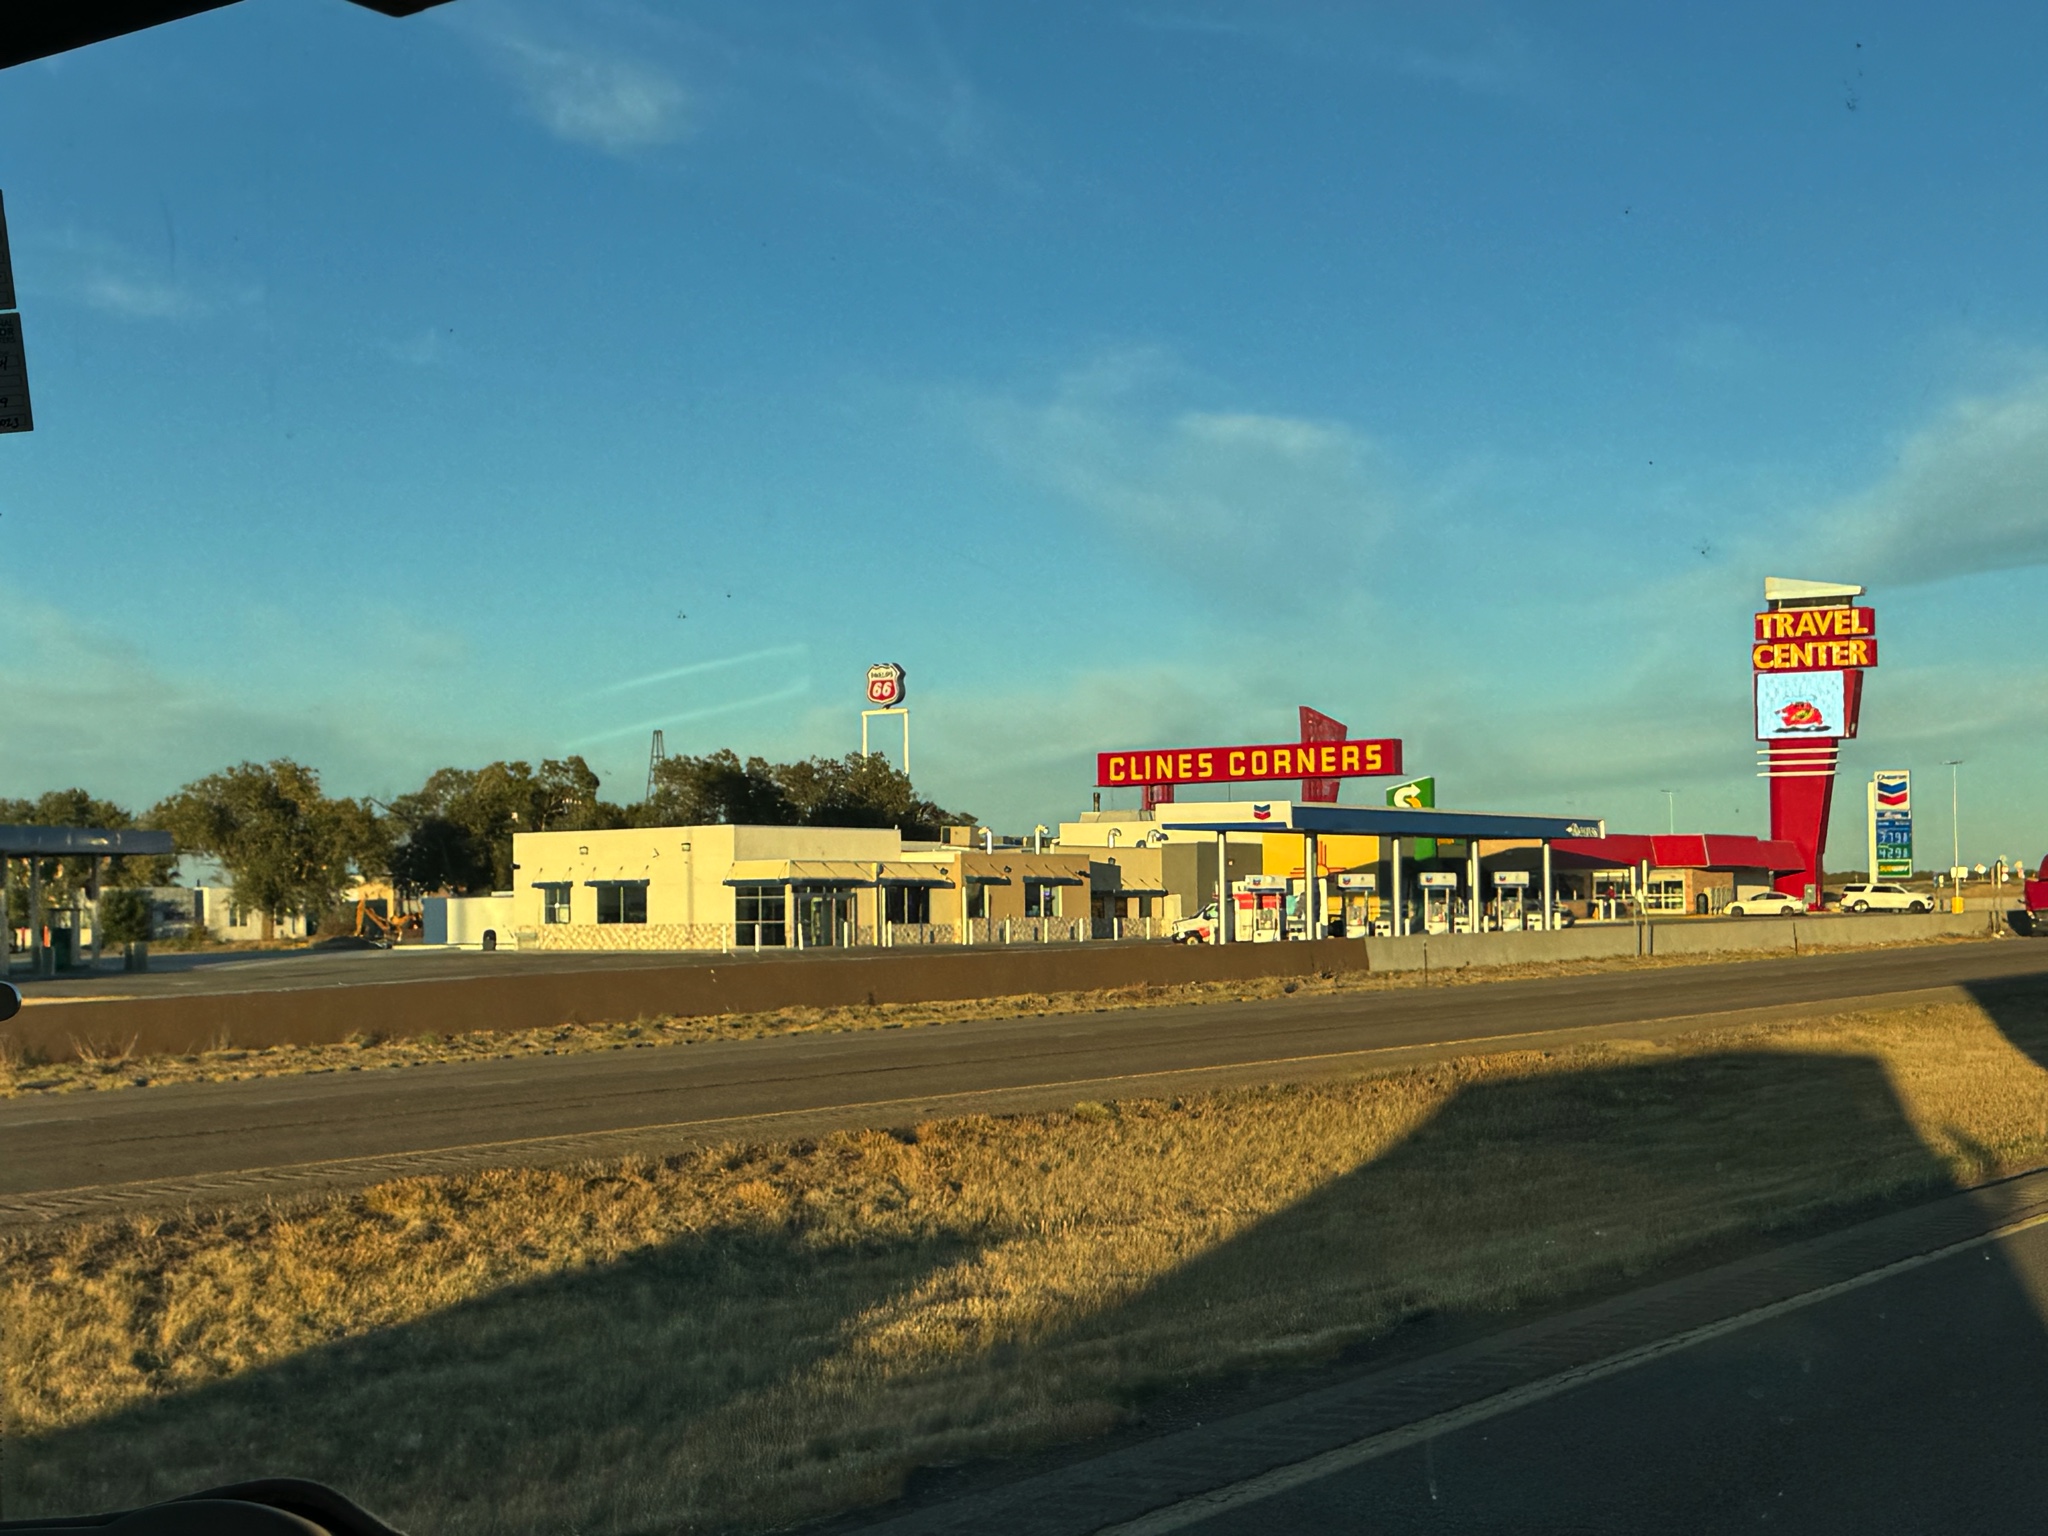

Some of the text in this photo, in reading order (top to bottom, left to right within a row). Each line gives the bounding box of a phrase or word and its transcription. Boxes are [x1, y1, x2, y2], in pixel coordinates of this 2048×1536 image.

[1756, 609, 1869, 639] TRAVEL
[1753, 639, 1868, 669] CENTER
[872, 681, 892, 697] 66
[1109, 744, 1383, 782] CLINES CORNERS
